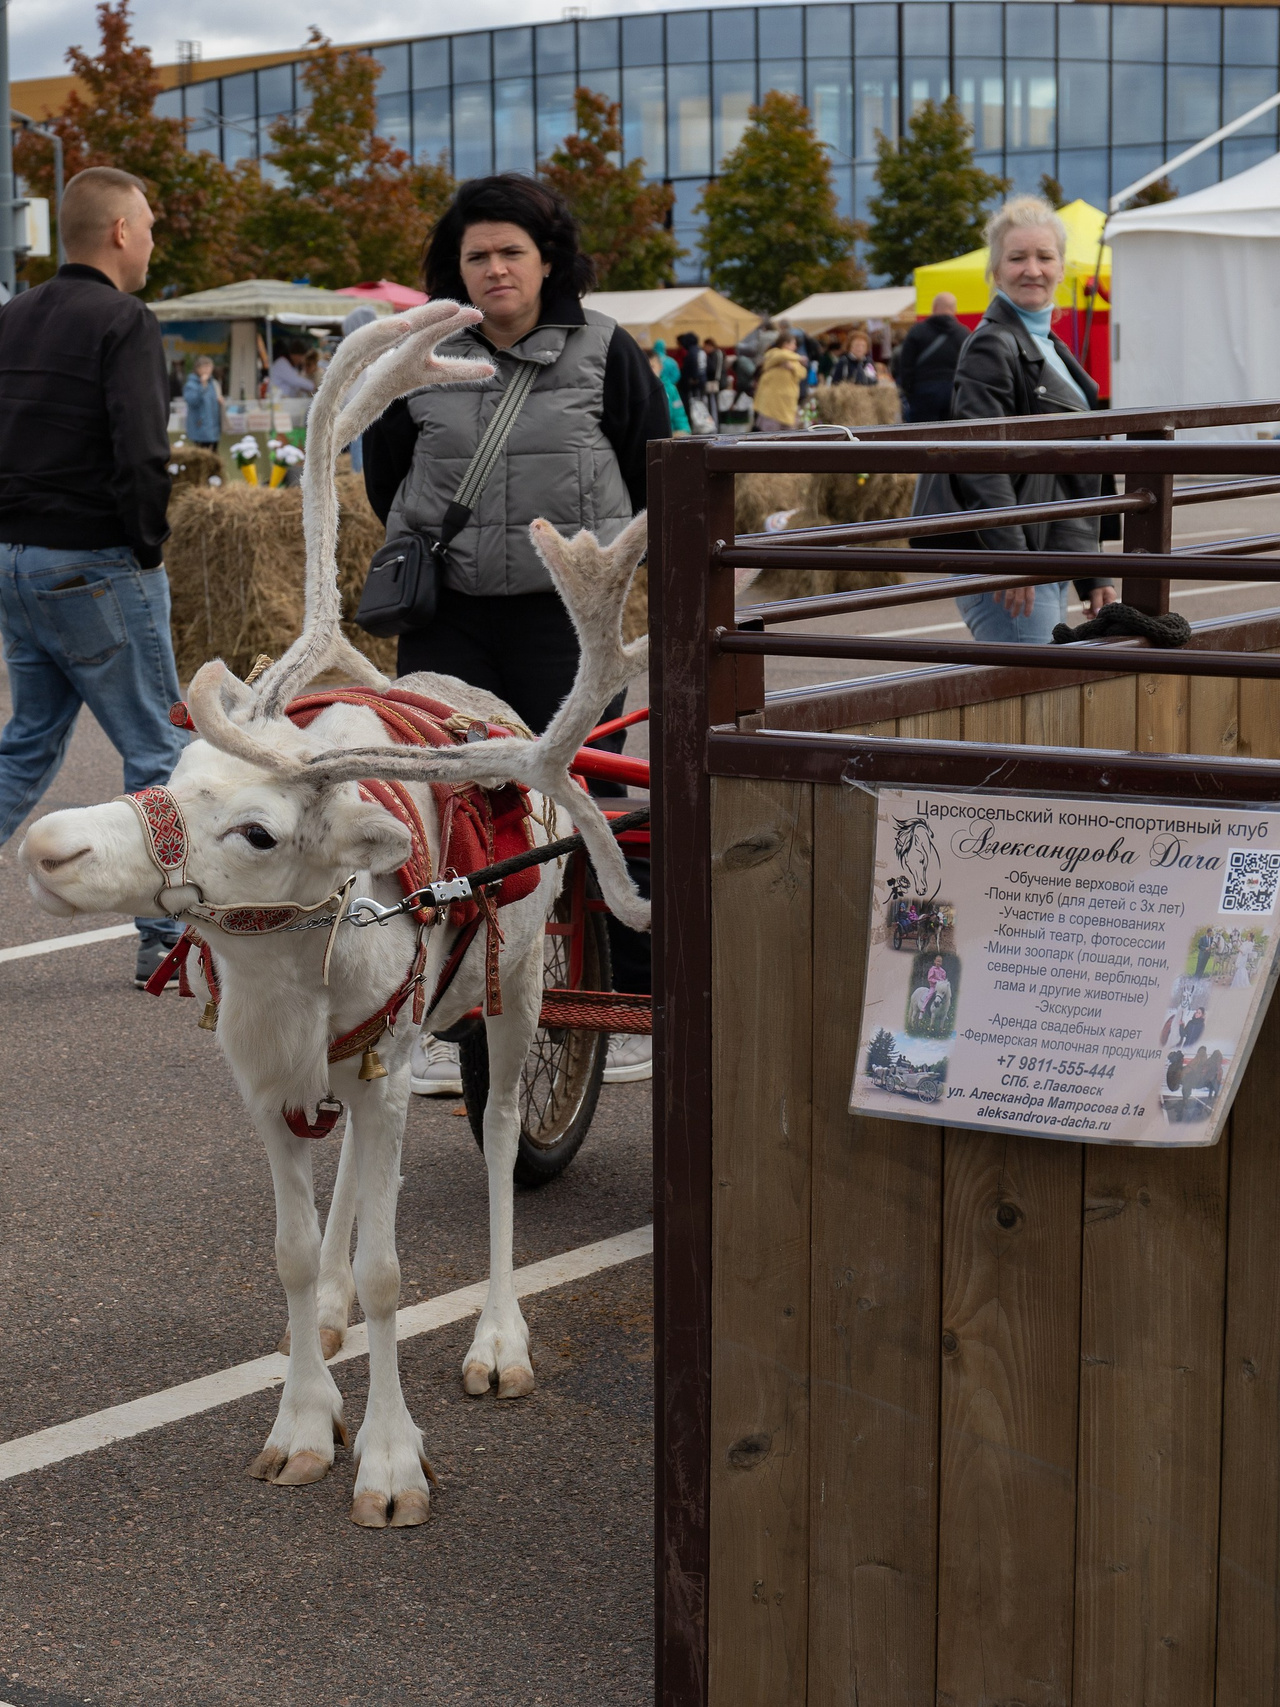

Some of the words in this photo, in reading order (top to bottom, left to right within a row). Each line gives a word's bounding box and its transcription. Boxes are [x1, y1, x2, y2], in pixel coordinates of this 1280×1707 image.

[916, 799, 1053, 824] Царскосельский
[1058, 813, 1222, 835] конно-спортивный
[1227, 821, 1269, 841] клуб
[950, 818, 1140, 873] Александрова
[1004, 870, 1071, 888] -Обучение
[1075, 877, 1135, 893] верховой
[1138, 882, 1168, 896] езде
[984, 886, 1021, 902] -Пони
[1024, 891, 1054, 907] клуб
[1057, 892, 1085, 908] (для
[1088, 897, 1126, 911] детей
[1129, 901, 1137, 912] с
[1140, 899, 1154, 913] 3х
[1158, 901, 1185, 918] лет)
[999, 906, 1055, 922] -Участие
[1058, 913, 1066, 923] в
[1069, 914, 1166, 932] соревнованиях
[994, 923, 1046, 940] -Конный
[1049, 930, 1087, 946] театр,
[1091, 932, 1166, 950] фотосессии
[983, 940, 1021, 955] -Мини
[1024, 945, 1074, 961] зоопарк
[1077, 948, 1133, 967] (лошади,
[1137, 955, 1170, 970] пони,
[987, 960, 1047, 976] северные
[1050, 966, 1090, 982] олени,
[1094, 970, 1160, 988] верблюды,
[993, 980, 1026, 992] лама
[1029, 984, 1036, 993] и
[1039, 984, 1081, 999] другие
[1084, 988, 1149, 1006] животные)
[1035, 999, 1102, 1018] -Экскурсии
[988, 1012, 1037, 1030] -Аренда
[1040, 1020, 1105, 1037] свадебных
[1108, 1027, 1142, 1040] карет
[959, 1028, 1037, 1048] -Фермерская
[1040, 1039, 1099, 1054] молочная
[1102, 1045, 1162, 1061] продукция
[997, 1054, 1016, 1068] +7
[1018, 1056, 1116, 1079] 9811-555-444
[1001, 1073, 1029, 1088] СПб.
[1033, 1079, 1105, 1096] г.Павловск
[947, 1086, 966, 1099] ул.
[969, 1087, 1045, 1107] Алескандра
[1047, 1096, 1118, 1115] Матросова
[1121, 1103, 1146, 1117] д.1а
[977, 1105, 1112, 1131] aleksandrova-dacha.ru
